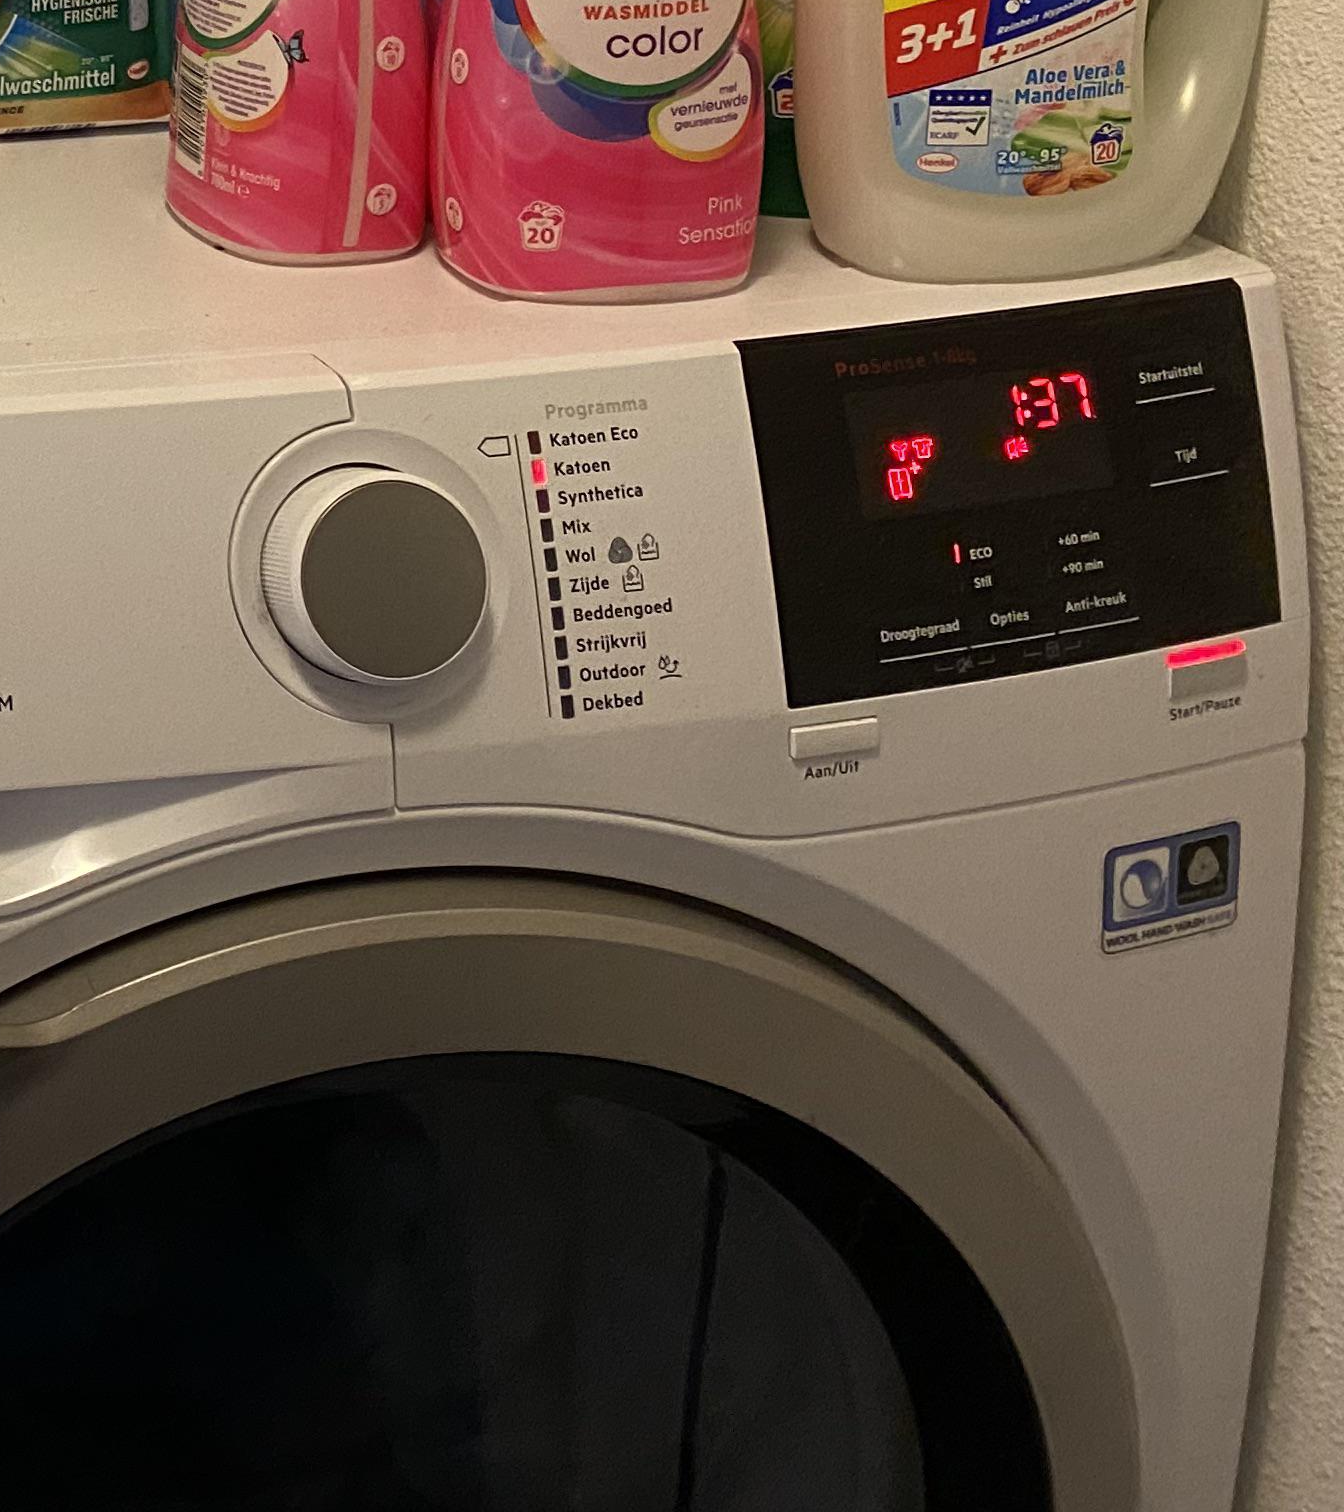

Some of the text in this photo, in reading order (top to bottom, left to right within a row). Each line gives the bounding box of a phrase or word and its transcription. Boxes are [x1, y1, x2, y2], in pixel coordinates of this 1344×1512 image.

[63, 5, 119, 26] FRISCHE
[896, 8, 977, 64] 3+1
[996, 13, 1039, 36] Reinheit
[1012, 1, 1121, 55] Zum schlauen Preis
[605, 24, 704, 60] color
[1025, 59, 1126, 85] Aloe Vera &
[719, 82, 738, 94] met
[1015, 79, 1124, 105] Mandelmilch
[670, 94, 749, 117] vernieuwde
[674, 112, 738, 132] geursensatie
[1095, 143, 1115, 160] 20
[707, 196, 743, 215] Pink
[527, 227, 555, 245] 20
[1138, 362, 1204, 385] Startuitstel
[545, 398, 649, 419] Programma
[1010, 373, 1094, 429] 1:37
[550, 426, 639, 447] Katoen Eco
[1174, 447, 1198, 463] Tijd
[554, 459, 611, 476] Katoen
[558, 484, 644, 507] Synthetica
[562, 519, 592, 535] Mix
[566, 546, 596, 564] Wol
[968, 529, 1101, 561] ECO +60 min
[973, 557, 1104, 589] Stil +90 min
[569, 576, 610, 596] Zijde
[573, 598, 673, 623] Beddengoed
[879, 591, 1127, 643] Droogtegraad Opties Anti-kreuk
[576, 631, 647, 653] Strijkvrij
[579, 664, 646, 682] Outdoor
[583, 691, 644, 712] Dekbed
[1169, 694, 1242, 721] Start/Pauze
[804, 760, 860, 781] Aan/Uit
